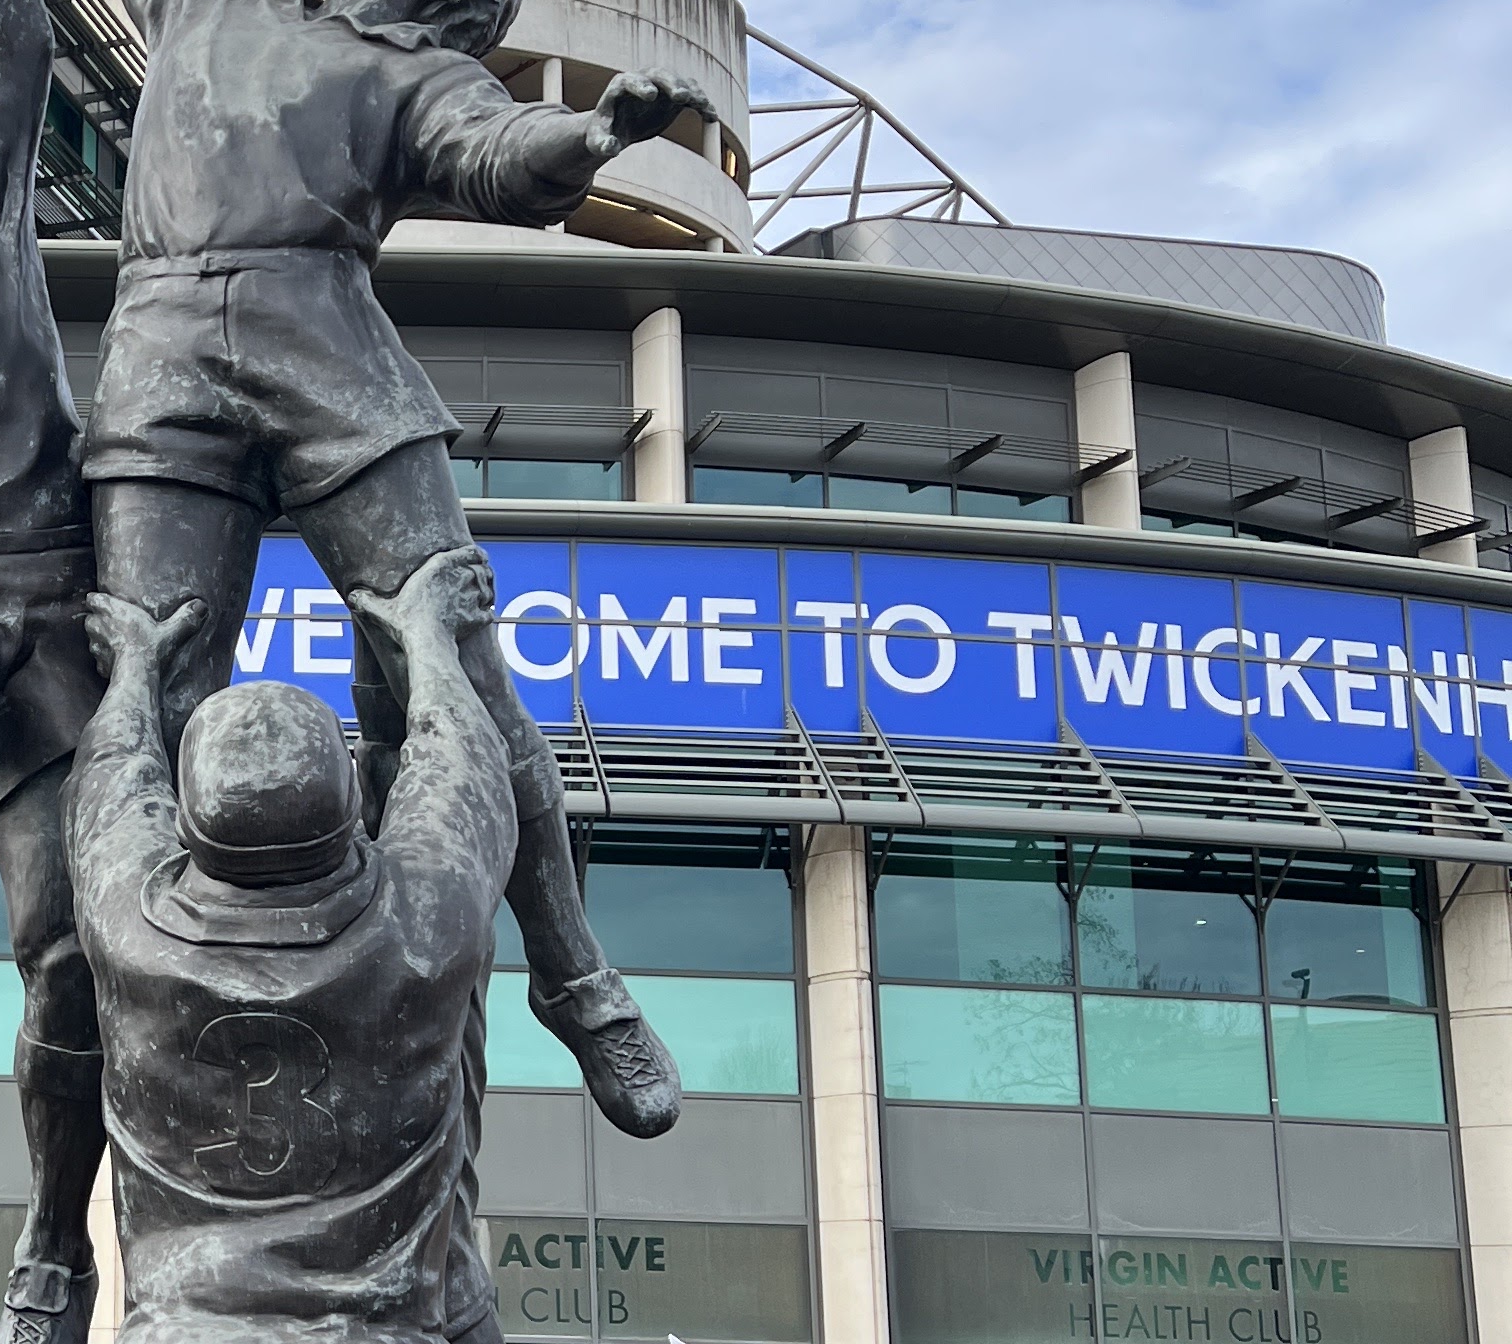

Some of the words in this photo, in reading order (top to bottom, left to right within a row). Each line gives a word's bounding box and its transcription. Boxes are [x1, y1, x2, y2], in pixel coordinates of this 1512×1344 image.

[233, 588, 763, 685] EOME
[795, 601, 956, 694] TO
[988, 612, 1512, 740] TWICKENH
[498, 1233, 666, 1272] ACTIVE
[1027, 1248, 1186, 1286] VIRGIN
[1207, 1255, 1349, 1293] ACTIVE
[521, 1287, 629, 1324] CLUB
[1069, 1303, 1211, 1341] HEALTH
[1228, 1308, 1323, 1344] CLUB
